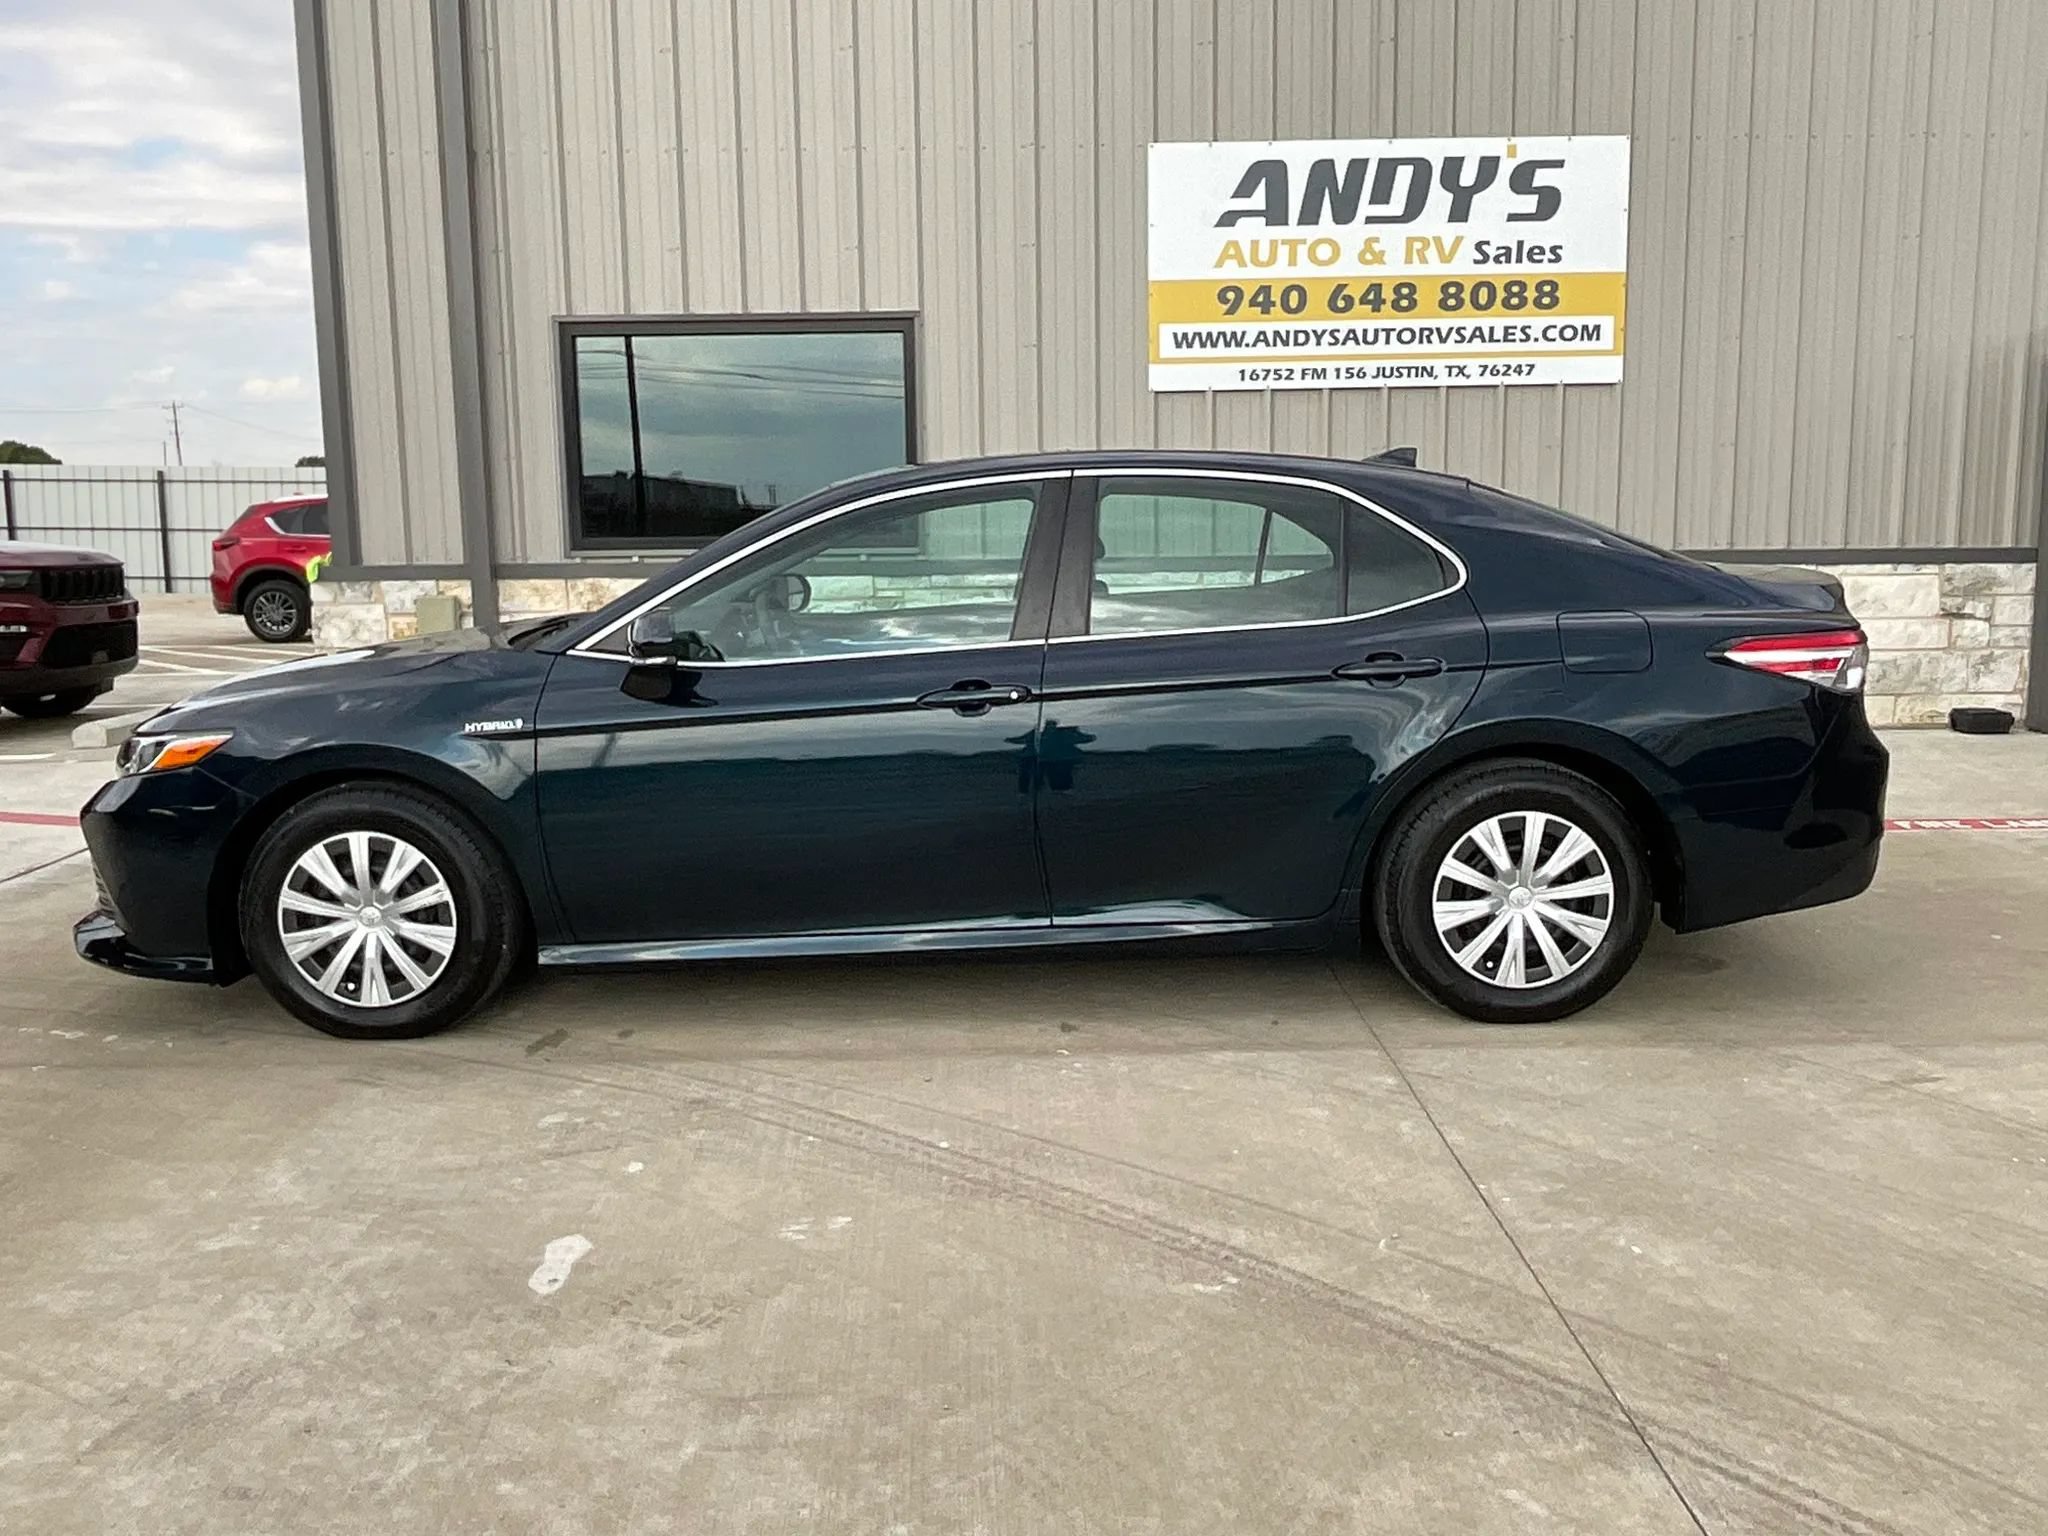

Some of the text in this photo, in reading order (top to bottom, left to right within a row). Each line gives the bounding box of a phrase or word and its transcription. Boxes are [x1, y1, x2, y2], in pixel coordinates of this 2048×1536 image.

[1214, 144, 1565, 228] ANDY'S
[1214, 235, 1563, 268] AUTO & RV Sales
[1216, 279, 1560, 316] 940 648 8088
[1172, 323, 1602, 350] WWW.ANDYSAUTORVSALES.COM
[1238, 363, 1536, 382] 16752 FM 156 JUSTIN, TX, 76247
